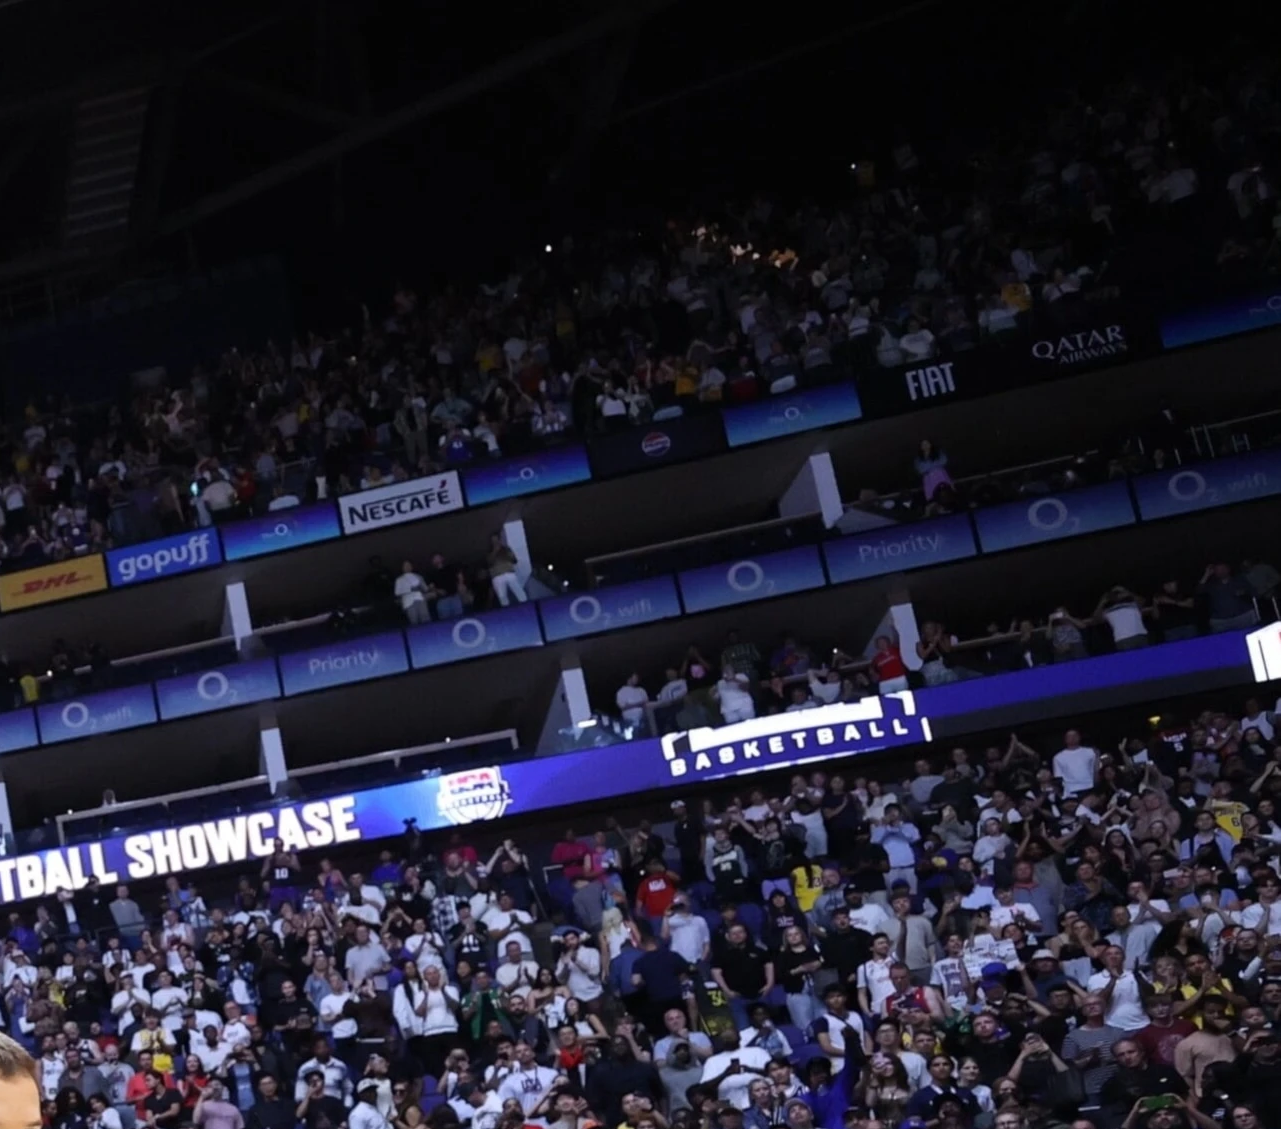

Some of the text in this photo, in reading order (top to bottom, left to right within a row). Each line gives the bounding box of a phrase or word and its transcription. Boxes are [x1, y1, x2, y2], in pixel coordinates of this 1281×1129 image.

[1031, 324, 1124, 360] QATAR
[1059, 341, 1128, 365] AIRWAYS
[904, 362, 957, 401] FIAT
[349, 479, 451, 525] NESCAFÉ
[117, 534, 210, 580] gopuff
[859, 532, 940, 566] Priority
[308, 647, 380, 677] Priority
[669, 718, 909, 777] BASKETBALL
[124, 796, 362, 880] SHOWCASE
